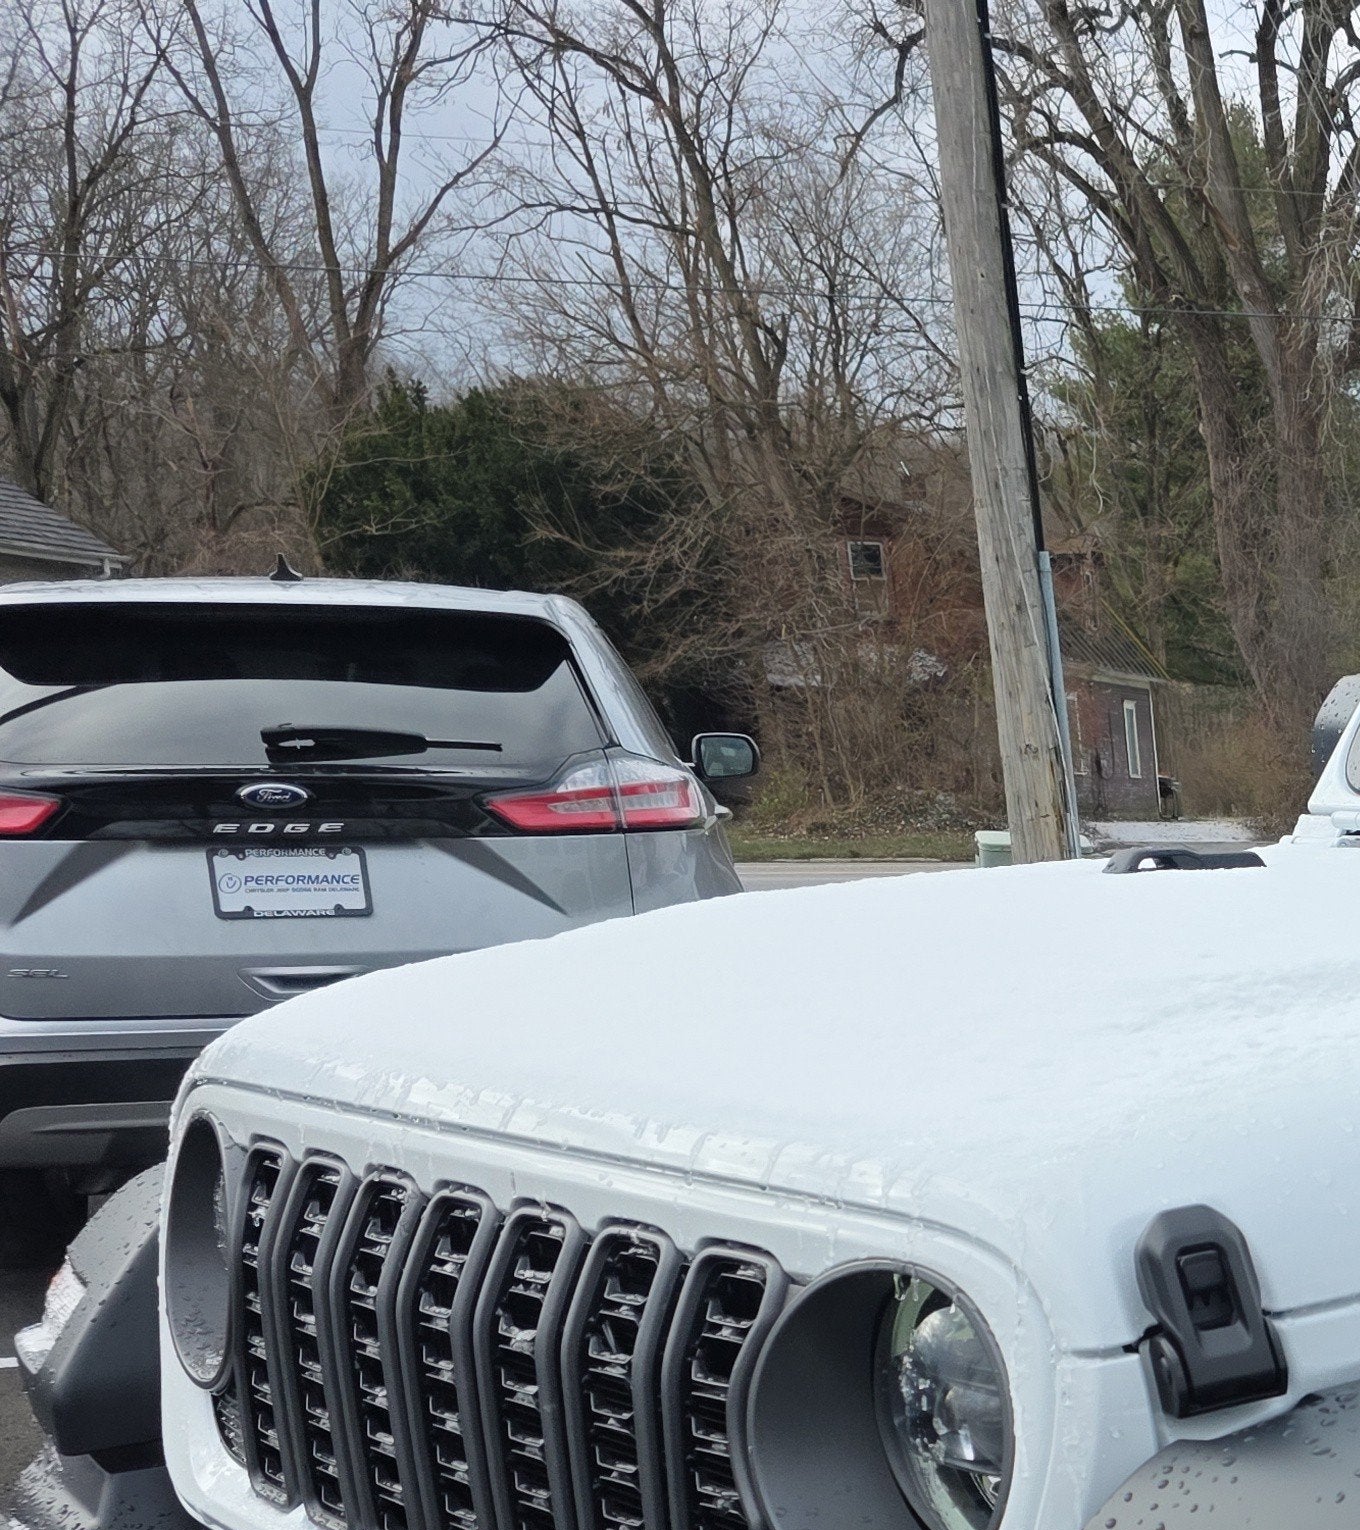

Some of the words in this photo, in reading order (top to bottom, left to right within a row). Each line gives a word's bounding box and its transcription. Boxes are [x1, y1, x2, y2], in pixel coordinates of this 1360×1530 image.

[257, 788, 291, 802] Ford
[213, 822, 345, 834] EDGE
[245, 848, 326, 857] PERFORMANCE
[244, 874, 360, 886] PERFORMANCE
[253, 909, 336, 917] DELAWARE
[7, 969, 68, 978] SEL
